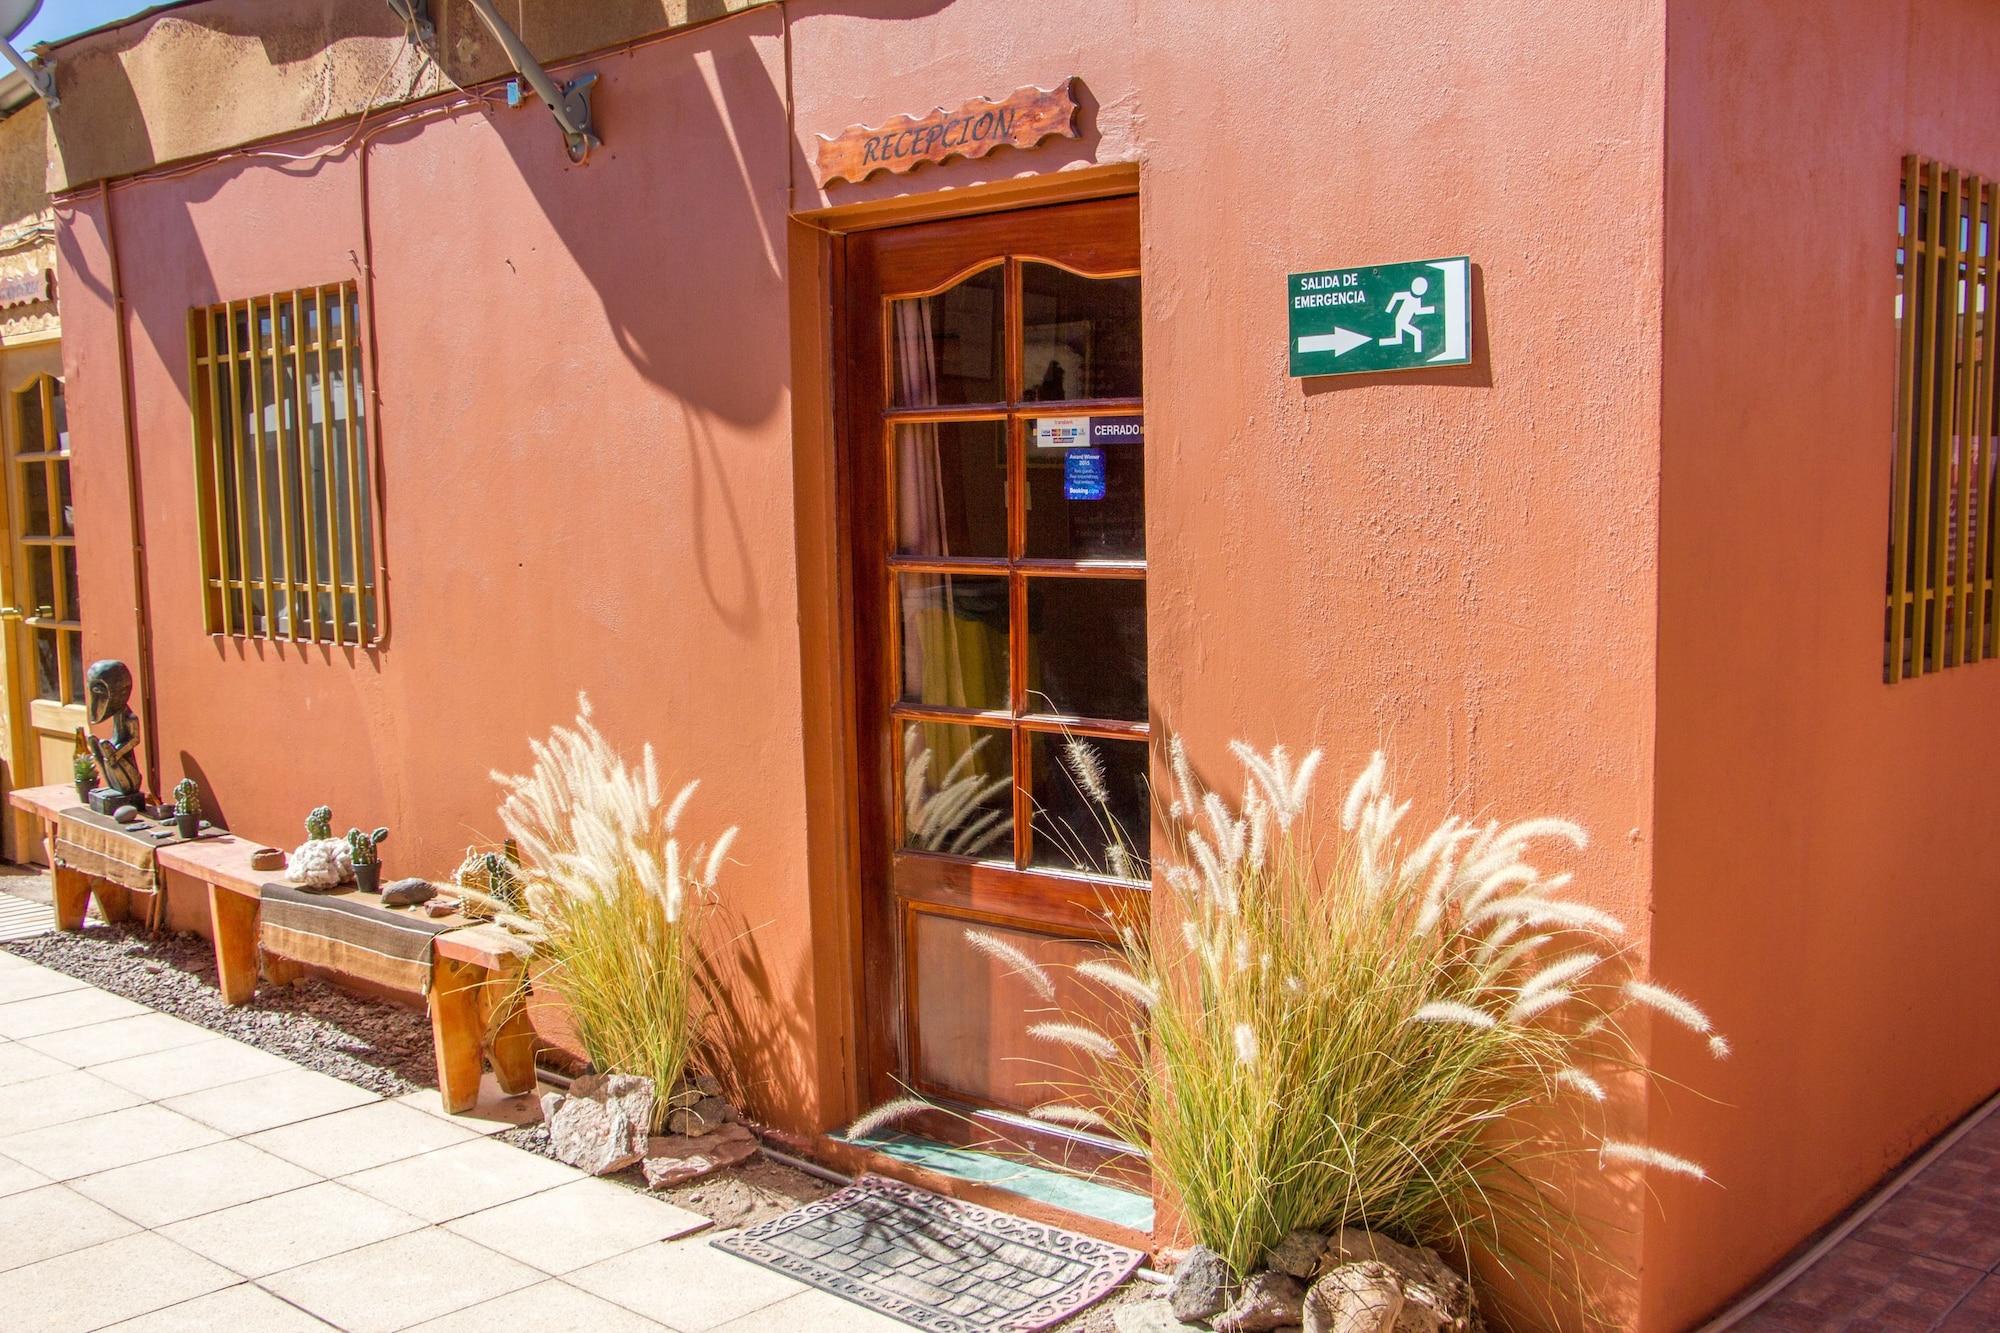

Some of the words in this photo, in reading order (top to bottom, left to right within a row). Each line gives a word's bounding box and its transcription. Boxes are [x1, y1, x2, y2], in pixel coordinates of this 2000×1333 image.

[862, 108, 1015, 165] RECEPCION
[1301, 275, 1340, 290] SALIDA
[1343, 273, 1358, 286] DE
[1295, 290, 1366, 308] EMERGENCIA
[1094, 424, 1140, 436] CERRADO
